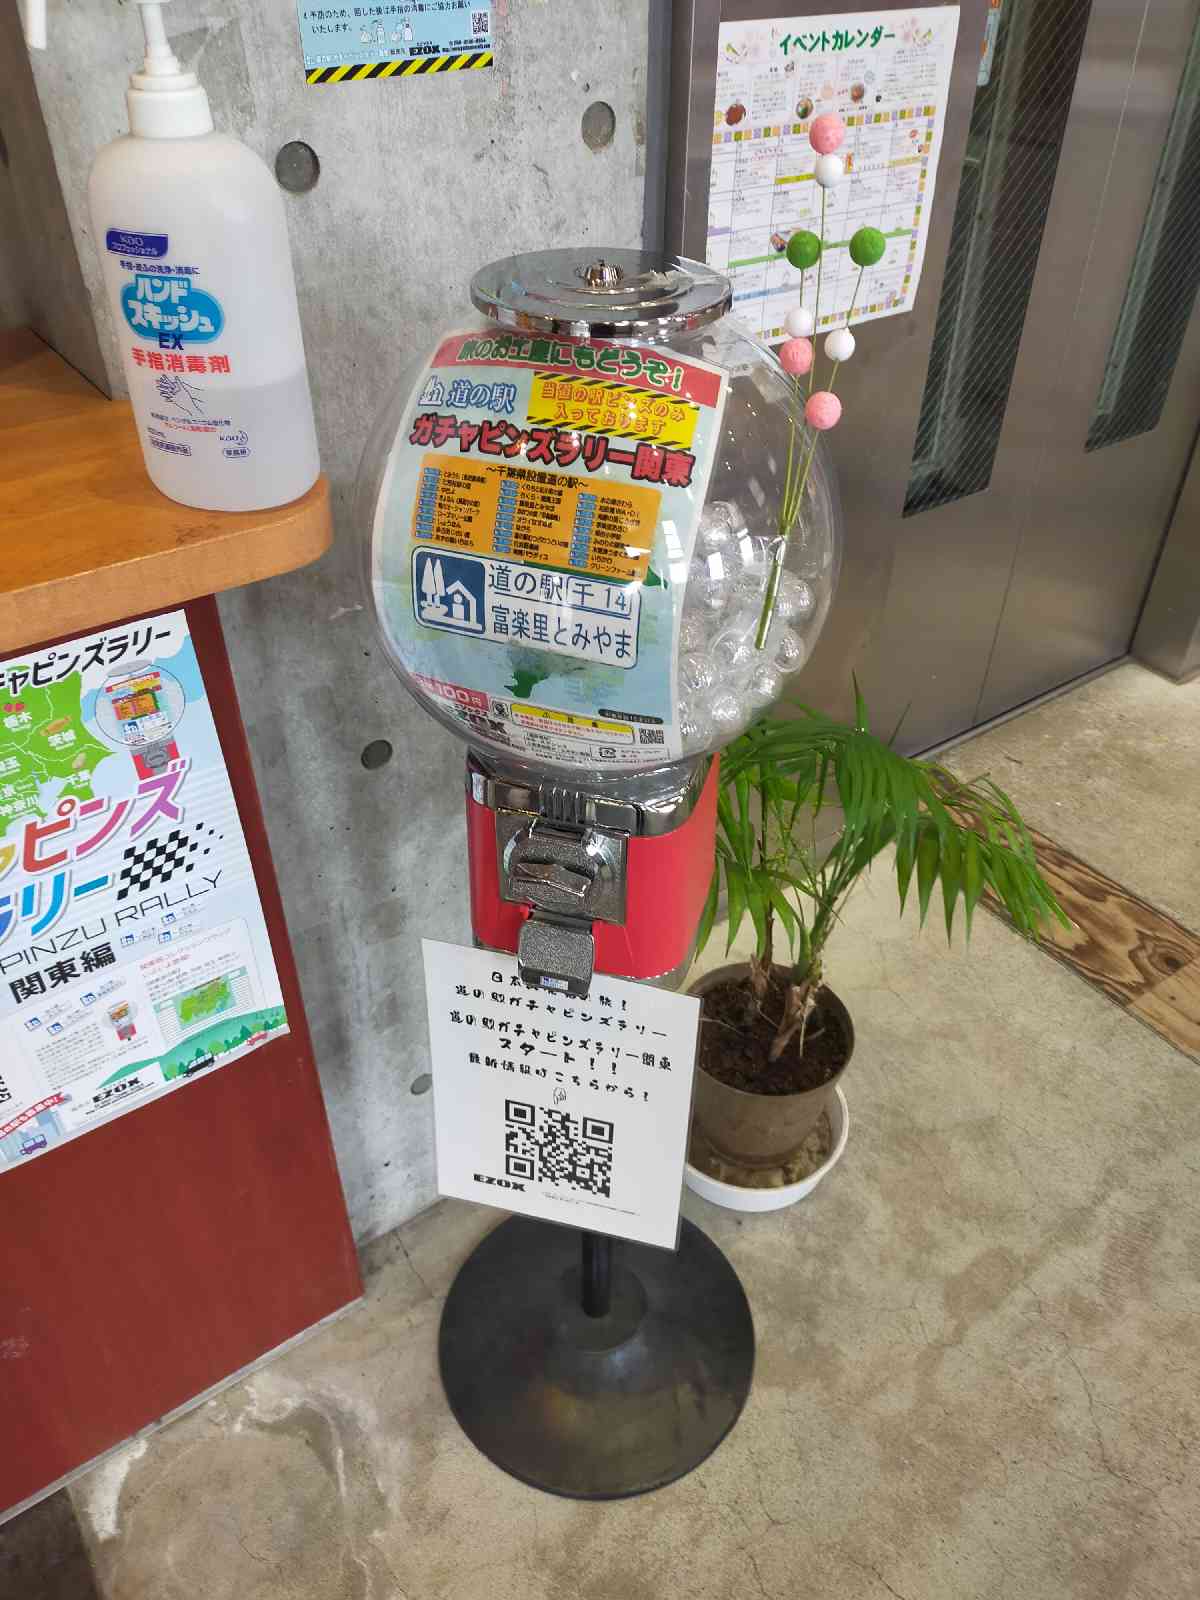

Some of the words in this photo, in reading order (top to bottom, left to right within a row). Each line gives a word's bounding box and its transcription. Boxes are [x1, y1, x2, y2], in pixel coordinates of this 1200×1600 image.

[409, 44, 440, 56] EZOX
[779, 26, 896, 56] イベントカレンダー
[136, 278, 189, 304] ハンド
[127, 300, 215, 333] スキッシュ
[158, 333, 184, 350] EX
[131, 347, 231, 373] 手指消毒剤
[448, 379, 517, 414] 道の駅
[408, 412, 697, 488] ガチャピンズラリー関東
[487, 563, 564, 601] 道の駅
[491, 604, 632, 659] 富楽里とみやま
[0, 626, 171, 695] ャピンズラリー
[0, 917, 107, 973] PINZU
[114, 869, 223, 927] RALLY
[8, 942, 117, 1004] 関東編
[92, 1077, 140, 1103] EZOX
[468, 1051, 650, 1102] 最新情報はこちらから!
[472, 1173, 527, 1192] EZOX
